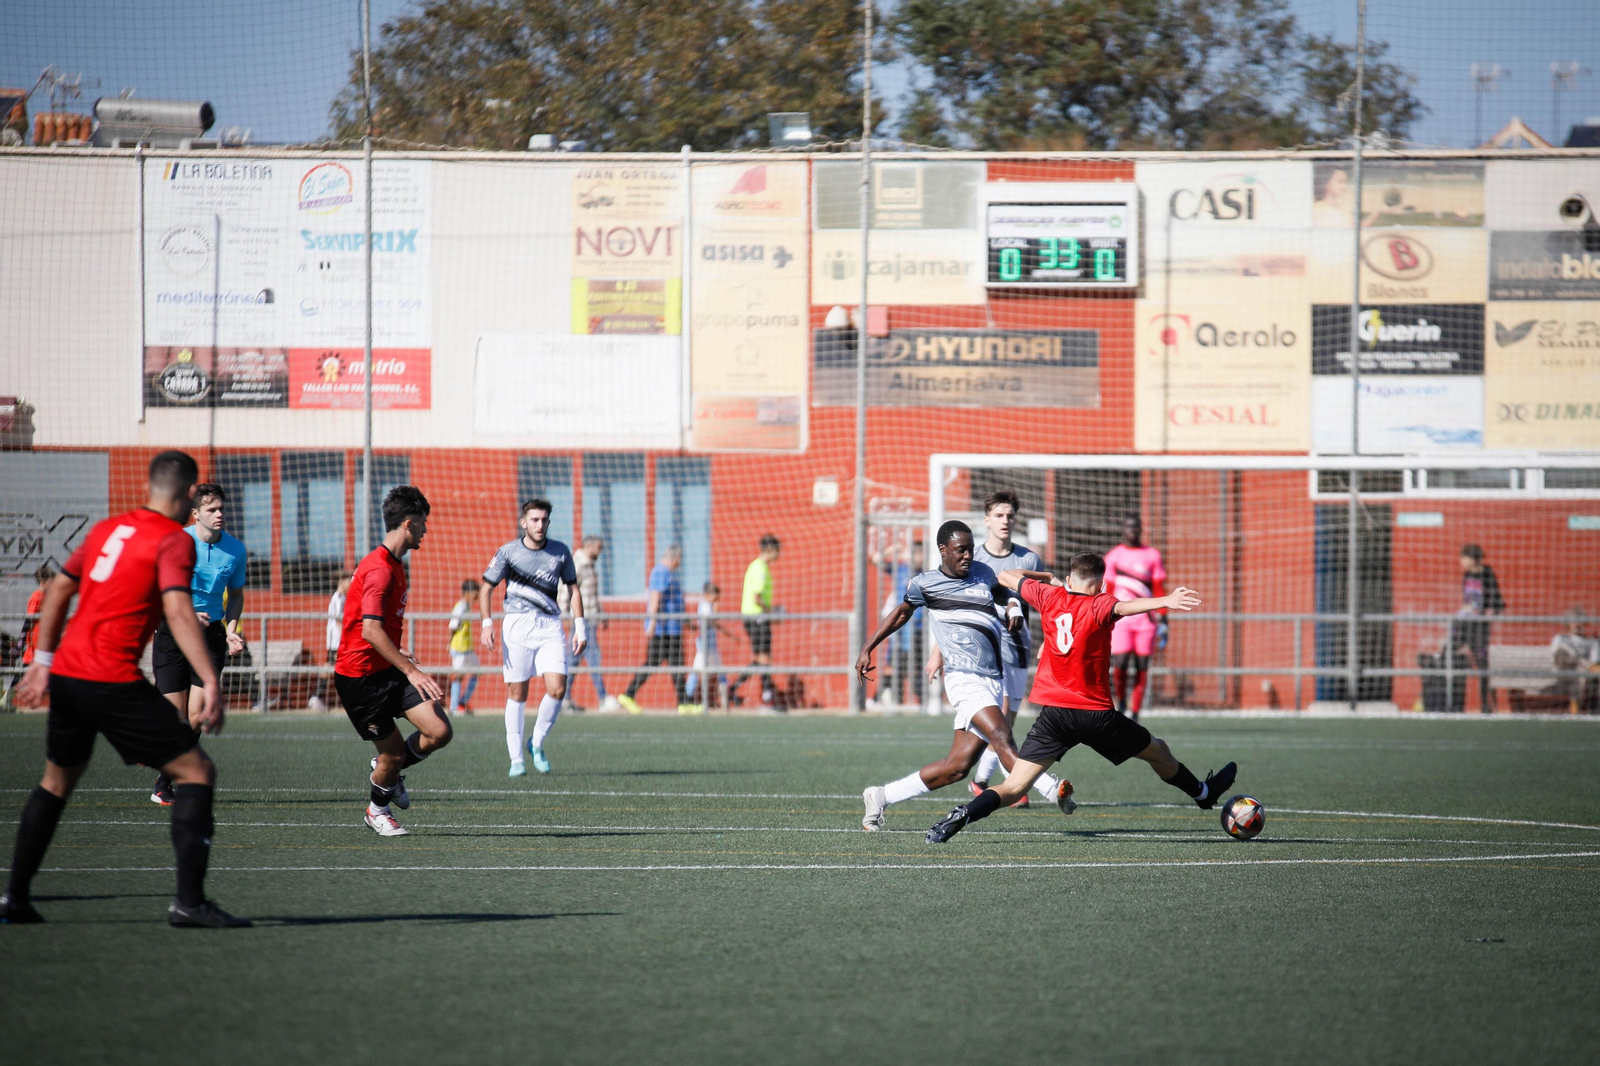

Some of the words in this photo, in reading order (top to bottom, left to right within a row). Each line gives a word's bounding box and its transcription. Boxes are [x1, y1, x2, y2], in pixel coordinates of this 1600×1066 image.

[575, 226, 673, 257] NOVI
[702, 244, 764, 262] asisa
[1000, 248, 1021, 281] 0
[1094, 249, 1116, 281] 0
[916, 336, 1064, 360] HYUNDAI
[1167, 404, 1278, 427] CESIAL
[89, 524, 137, 583] 5
[1055, 612, 1074, 655] 8
